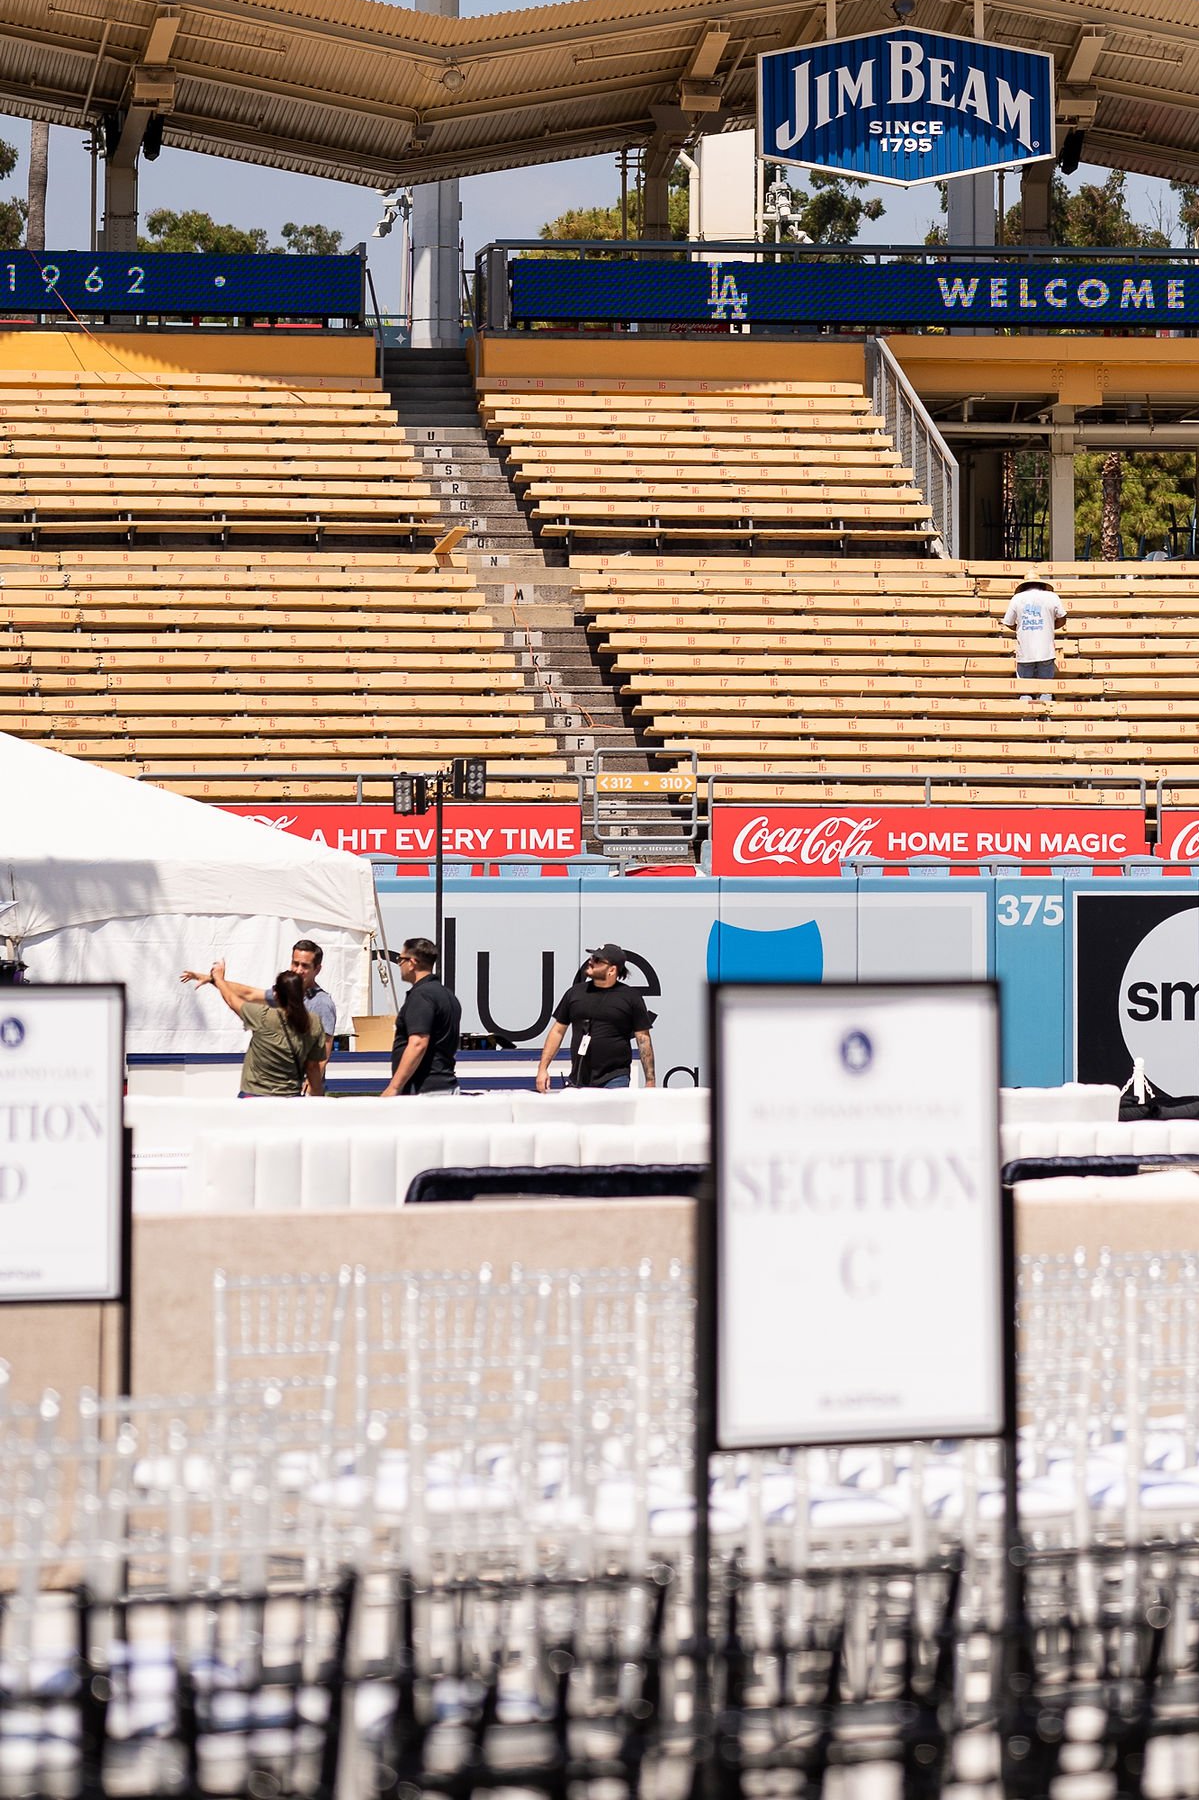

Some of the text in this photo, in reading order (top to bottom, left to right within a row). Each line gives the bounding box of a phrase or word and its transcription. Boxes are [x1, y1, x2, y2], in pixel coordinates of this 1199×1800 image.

[868, 120, 943, 135] SINCE
[880, 137, 933, 153] 1795
[707, 260, 748, 320] LA
[938, 277, 1185, 309] WELCOME
[427, 431, 435, 441] U
[435, 448, 442, 458] T
[445, 465, 452, 475] S
[452, 483, 459, 494] R
[471, 519, 479, 530] P
[490, 556, 498, 566] N
[564, 716, 572, 728] G
[577, 738, 585, 750] F
[586, 759, 594, 772] E
[610, 777, 682, 789] 312 310
[311, 829, 574, 850] A HIT EVERY TIME
[733, 816, 1126, 865] Coca-Cola HOME RUN MAGIC
[997, 894, 1064, 926] 375
[732, 1149, 979, 1216] SECTION
[838, 1236, 884, 1300] C
